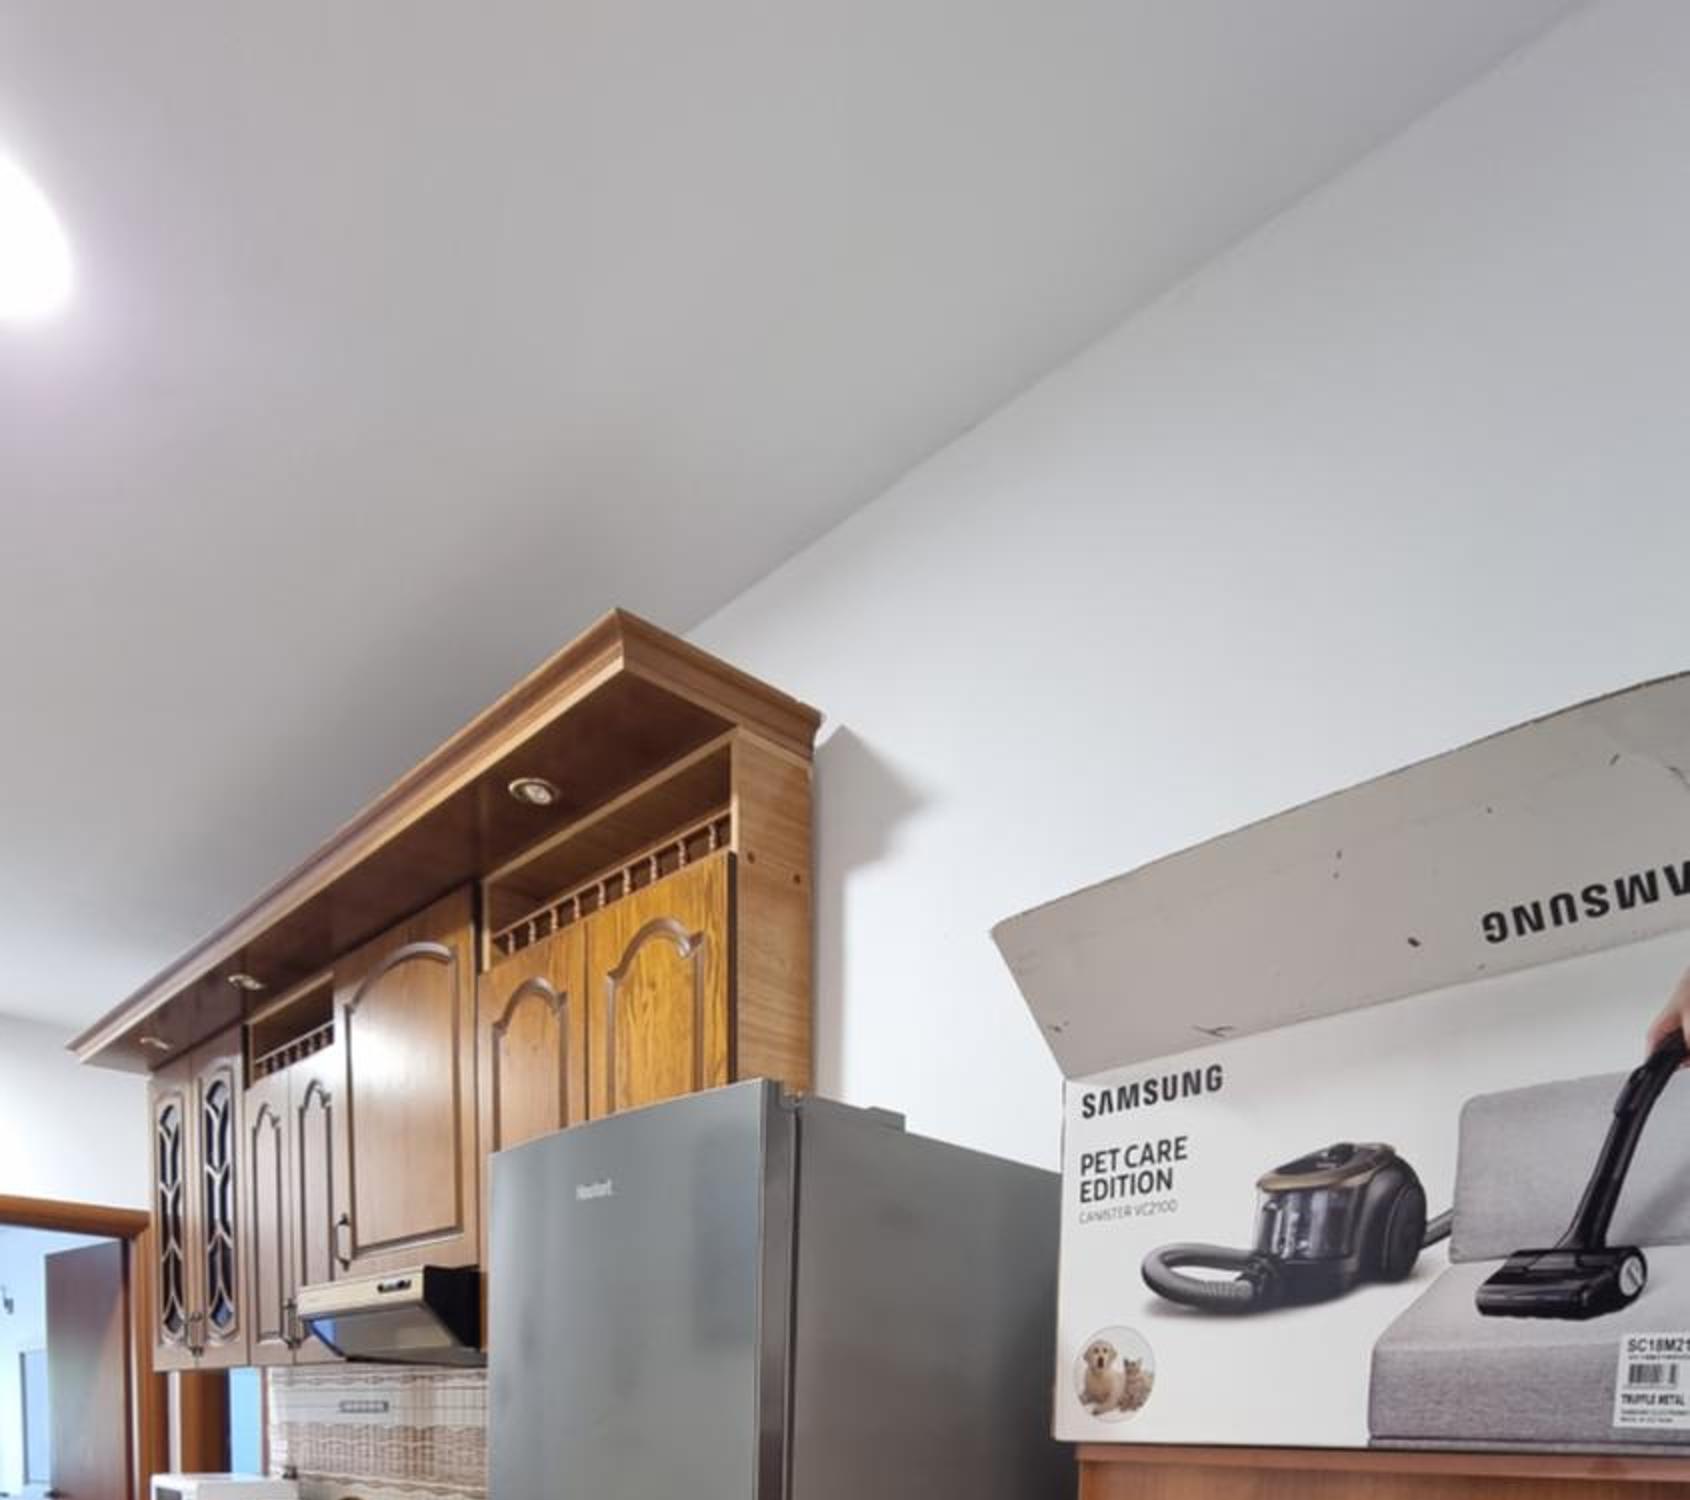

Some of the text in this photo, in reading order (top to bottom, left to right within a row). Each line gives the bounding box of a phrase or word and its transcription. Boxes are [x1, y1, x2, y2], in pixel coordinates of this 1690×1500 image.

[1082, 1064, 1223, 1119] SAMSUNG
[1080, 1136, 1188, 1176] PET CARE
[1080, 1168, 1173, 1203] EDITION
[1079, 1204, 1132, 1224] CANISTER
